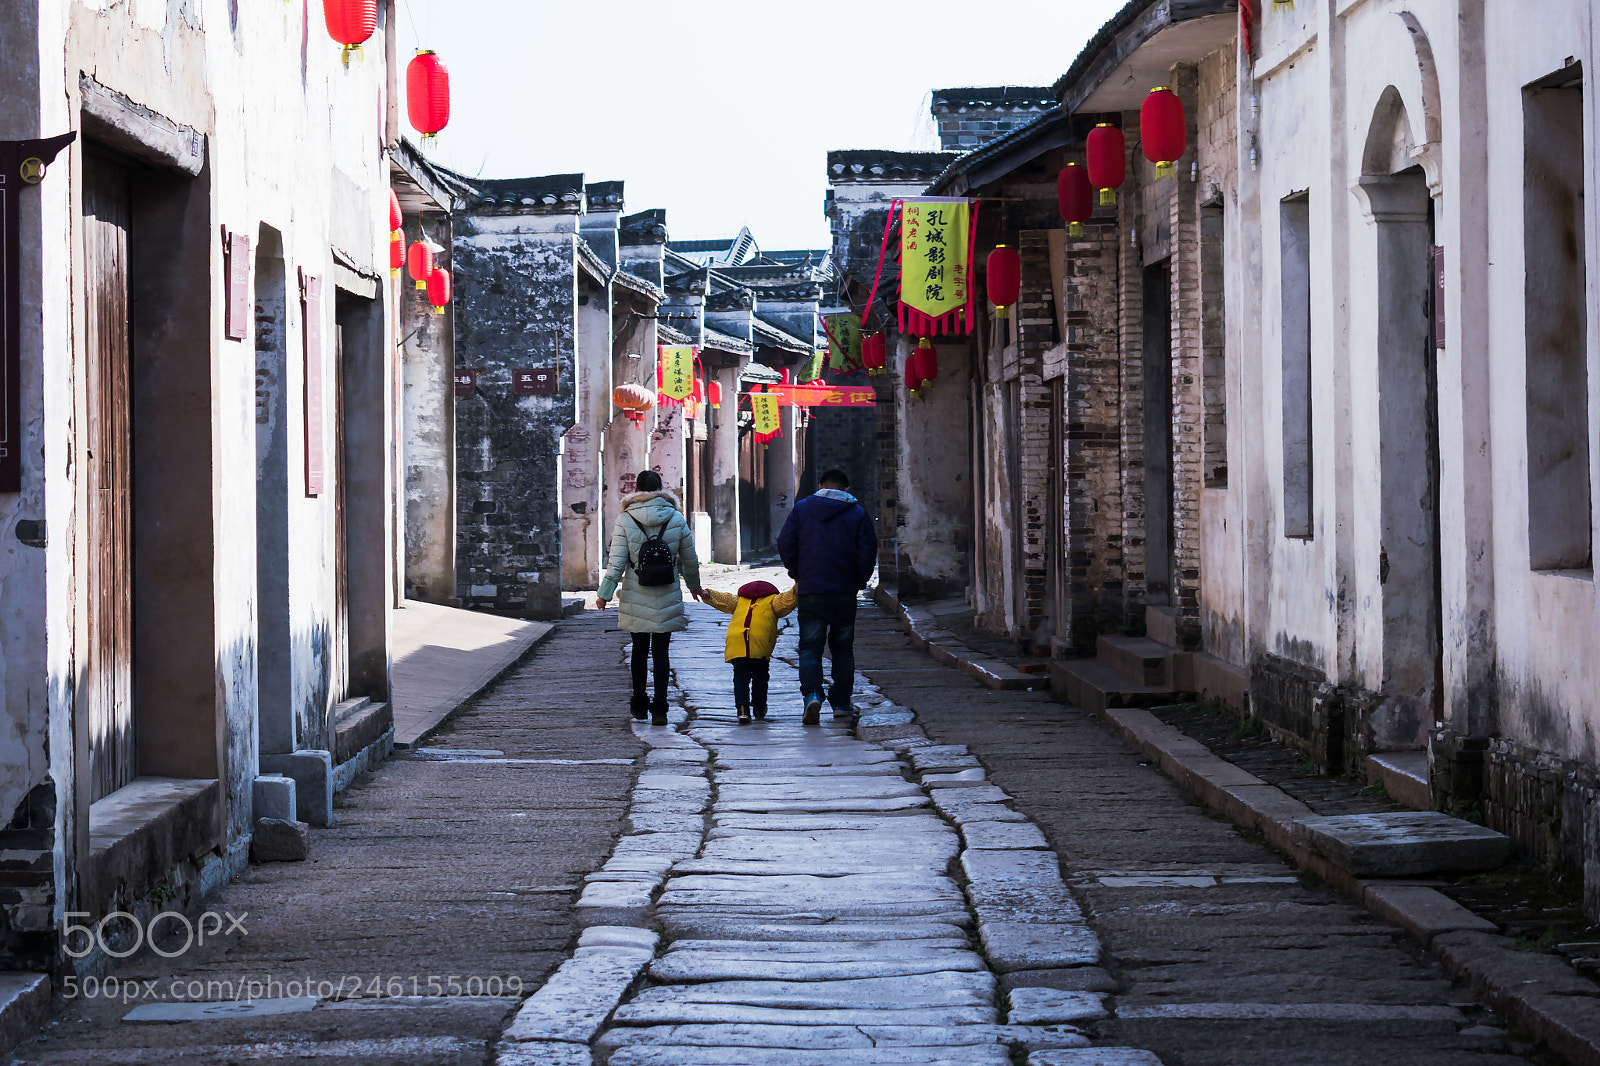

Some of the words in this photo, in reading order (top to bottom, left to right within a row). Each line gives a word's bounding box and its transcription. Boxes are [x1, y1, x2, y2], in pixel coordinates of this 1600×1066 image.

[907, 206, 919, 250] 桐城老酒
[924, 210, 948, 301] 孔城影剧院
[953, 264, 964, 300] 老字号
